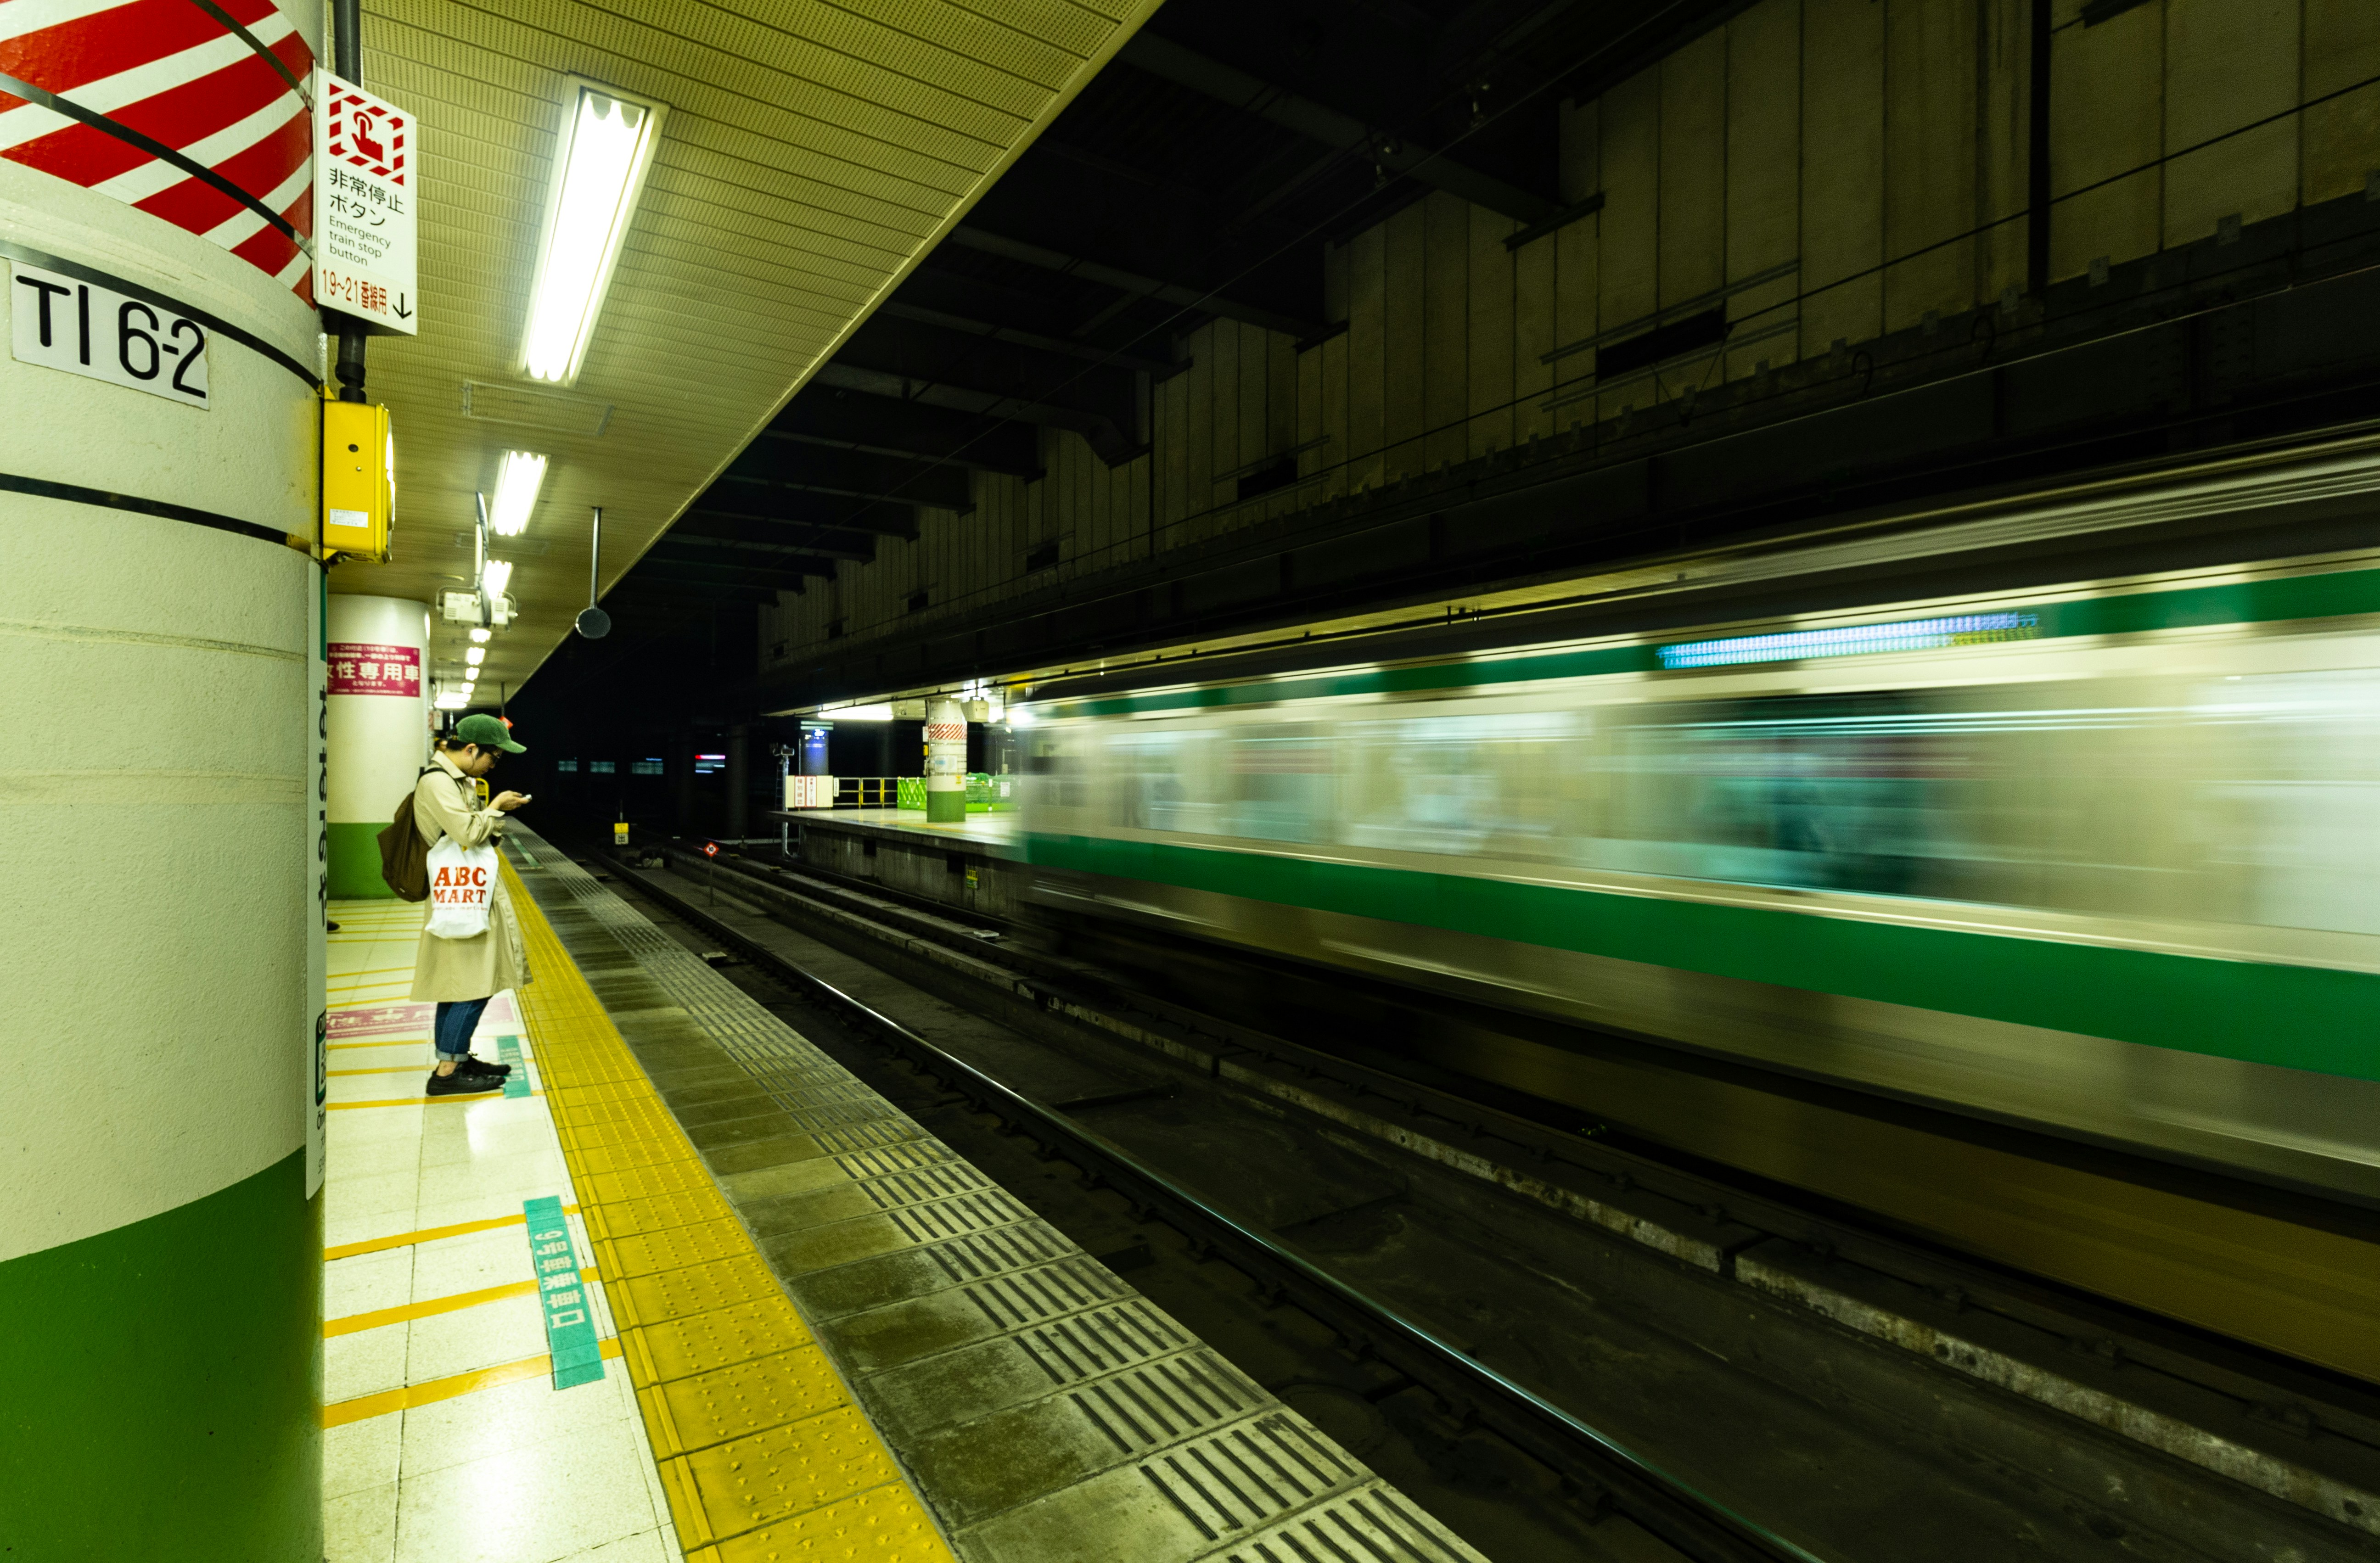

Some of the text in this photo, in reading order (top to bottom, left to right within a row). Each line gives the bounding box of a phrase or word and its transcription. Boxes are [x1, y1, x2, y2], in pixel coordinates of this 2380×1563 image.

[329, 168, 404, 214] 非常停止
[330, 194, 385, 225] ボタン
[330, 215, 391, 249] Emergency
[330, 231, 382, 258] train stop
[330, 243, 367, 266] button
[118, 301, 206, 399] 6-2
[434, 866, 487, 886] ABC
[433, 889, 486, 903] MART
[534, 1230, 585, 1328] 9号車乗車口
